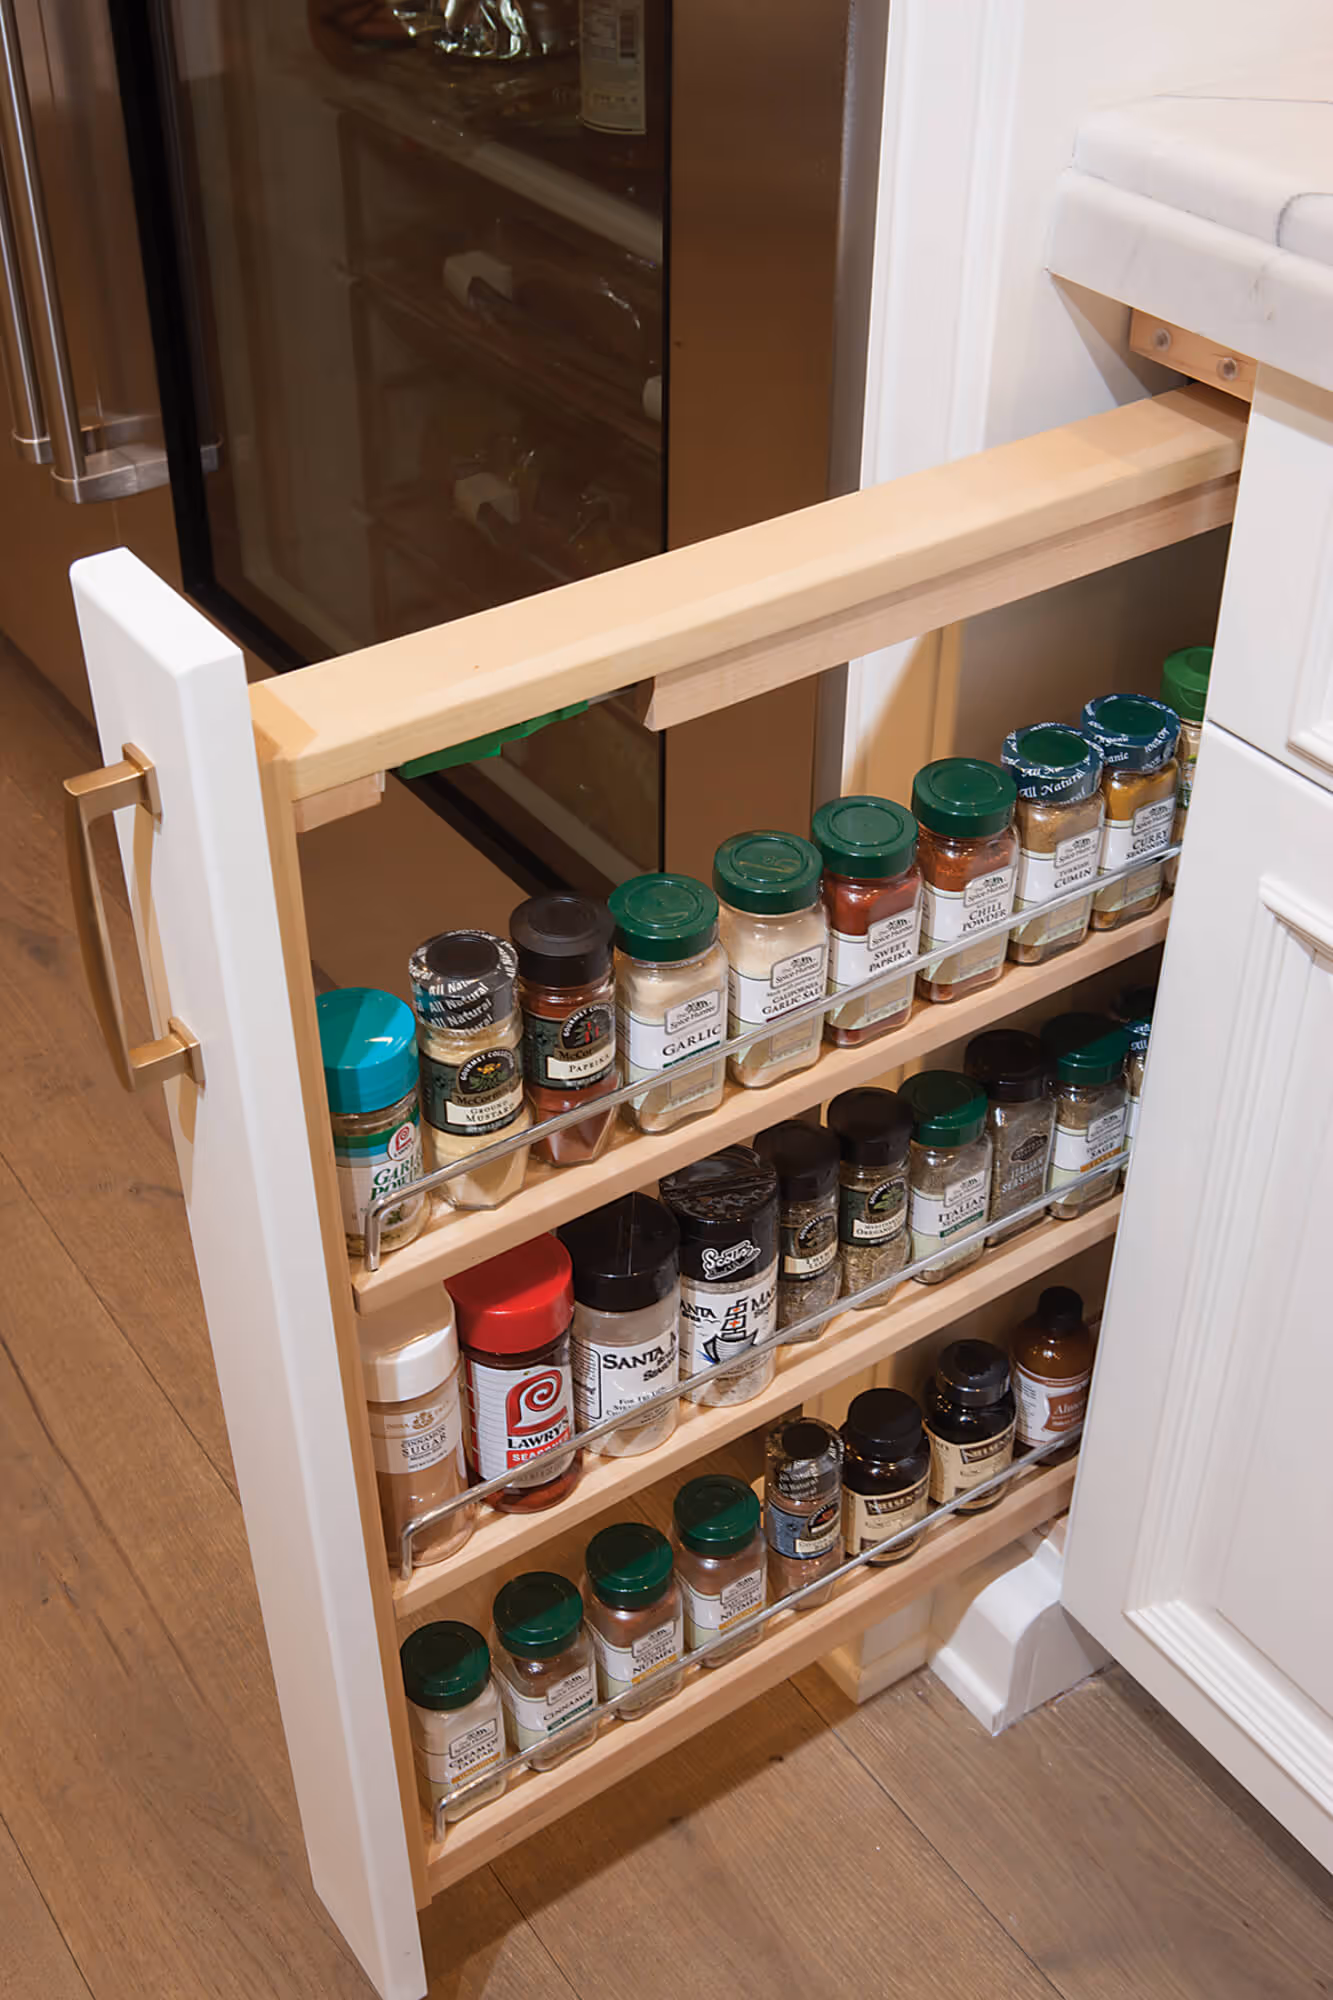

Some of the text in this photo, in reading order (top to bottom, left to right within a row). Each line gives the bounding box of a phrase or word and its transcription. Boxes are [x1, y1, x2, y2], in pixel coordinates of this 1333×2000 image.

[1040, 768, 1086, 796] Natural
[1132, 830, 1167, 851] CURRY
[1054, 867, 1092, 889] CUMIN
[962, 908, 1008, 932] POWDER
[969, 902, 1002, 921] CHILI
[869, 949, 913, 973] PAPRIKA
[873, 940, 909, 961] SWEET
[428, 982, 489, 1013] All Natural
[761, 984, 825, 1015] GARLIC SALT
[430, 998, 493, 1029] All Natural
[662, 1024, 722, 1057] GARLIC
[460, 1054, 487, 1081] GOURMET
[568, 1053, 610, 1073] PAPRIKA
[466, 1103, 515, 1122] MUSTARD
[938, 1195, 987, 1222] ITALIAN
[602, 1345, 665, 1370] SANTA
[401, 1431, 447, 1458] SUGAR
[507, 1419, 569, 1449] LAWRY'S
[633, 1645, 676, 1675] NUTMEG
[543, 1688, 593, 1720] CINNAMON
[448, 1746, 486, 1768] CREAM
